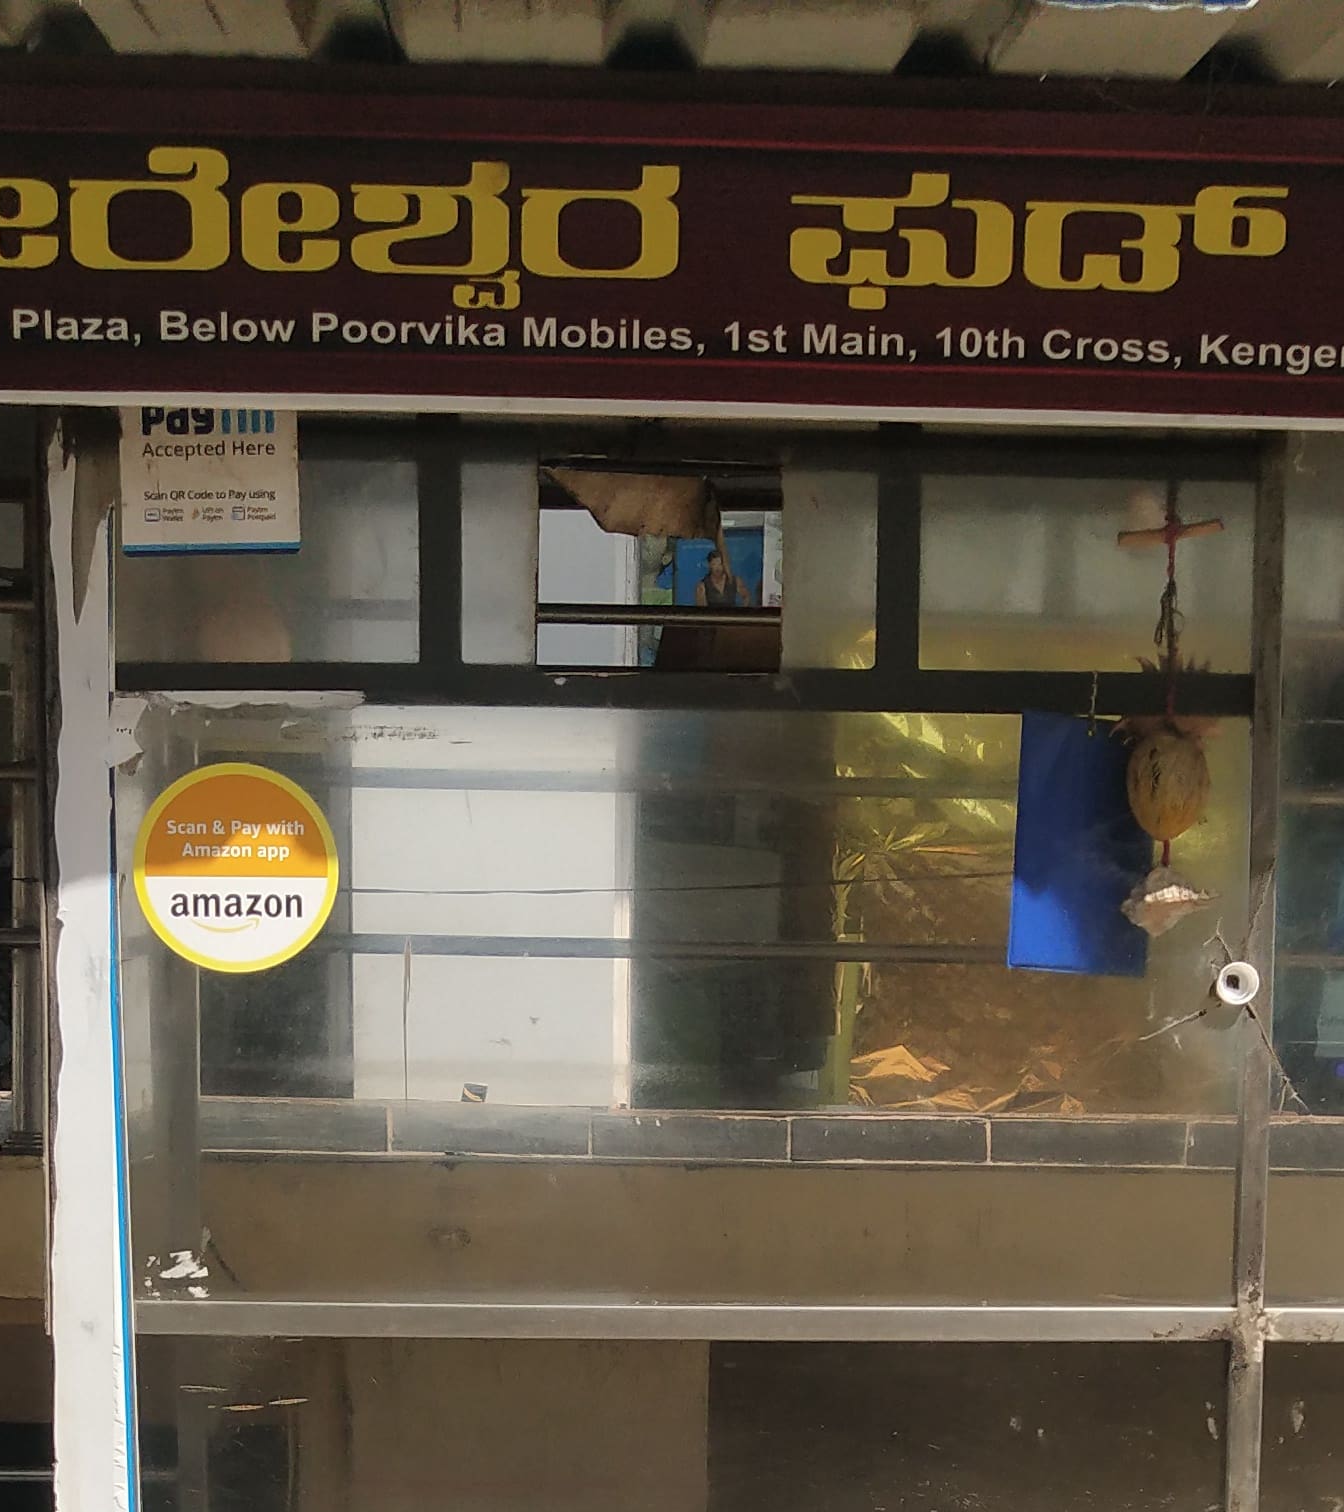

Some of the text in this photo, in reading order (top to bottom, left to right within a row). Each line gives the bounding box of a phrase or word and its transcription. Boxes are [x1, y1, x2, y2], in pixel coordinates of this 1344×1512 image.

[790, 173, 1288, 309] ಫುಡ್
[13, 309, 140, 346] Plaza,
[160, 311, 295, 341] Below
[313, 313, 505, 346] Poorvika
[524, 317, 704, 356] Mobiles,
[725, 322, 786, 352] 1st
[804, 324, 916, 361] Main,
[936, 327, 1024, 358] 10th
[1043, 330, 1181, 369] Cross,
[142, 440, 275, 460] Accepted Here
[144, 490, 276, 501] Scan QR Code to Pay using
[166, 819, 305, 840] Scan & Pay with
[182, 842, 290, 861] Amazon app
[171, 892, 304, 919] amazon
